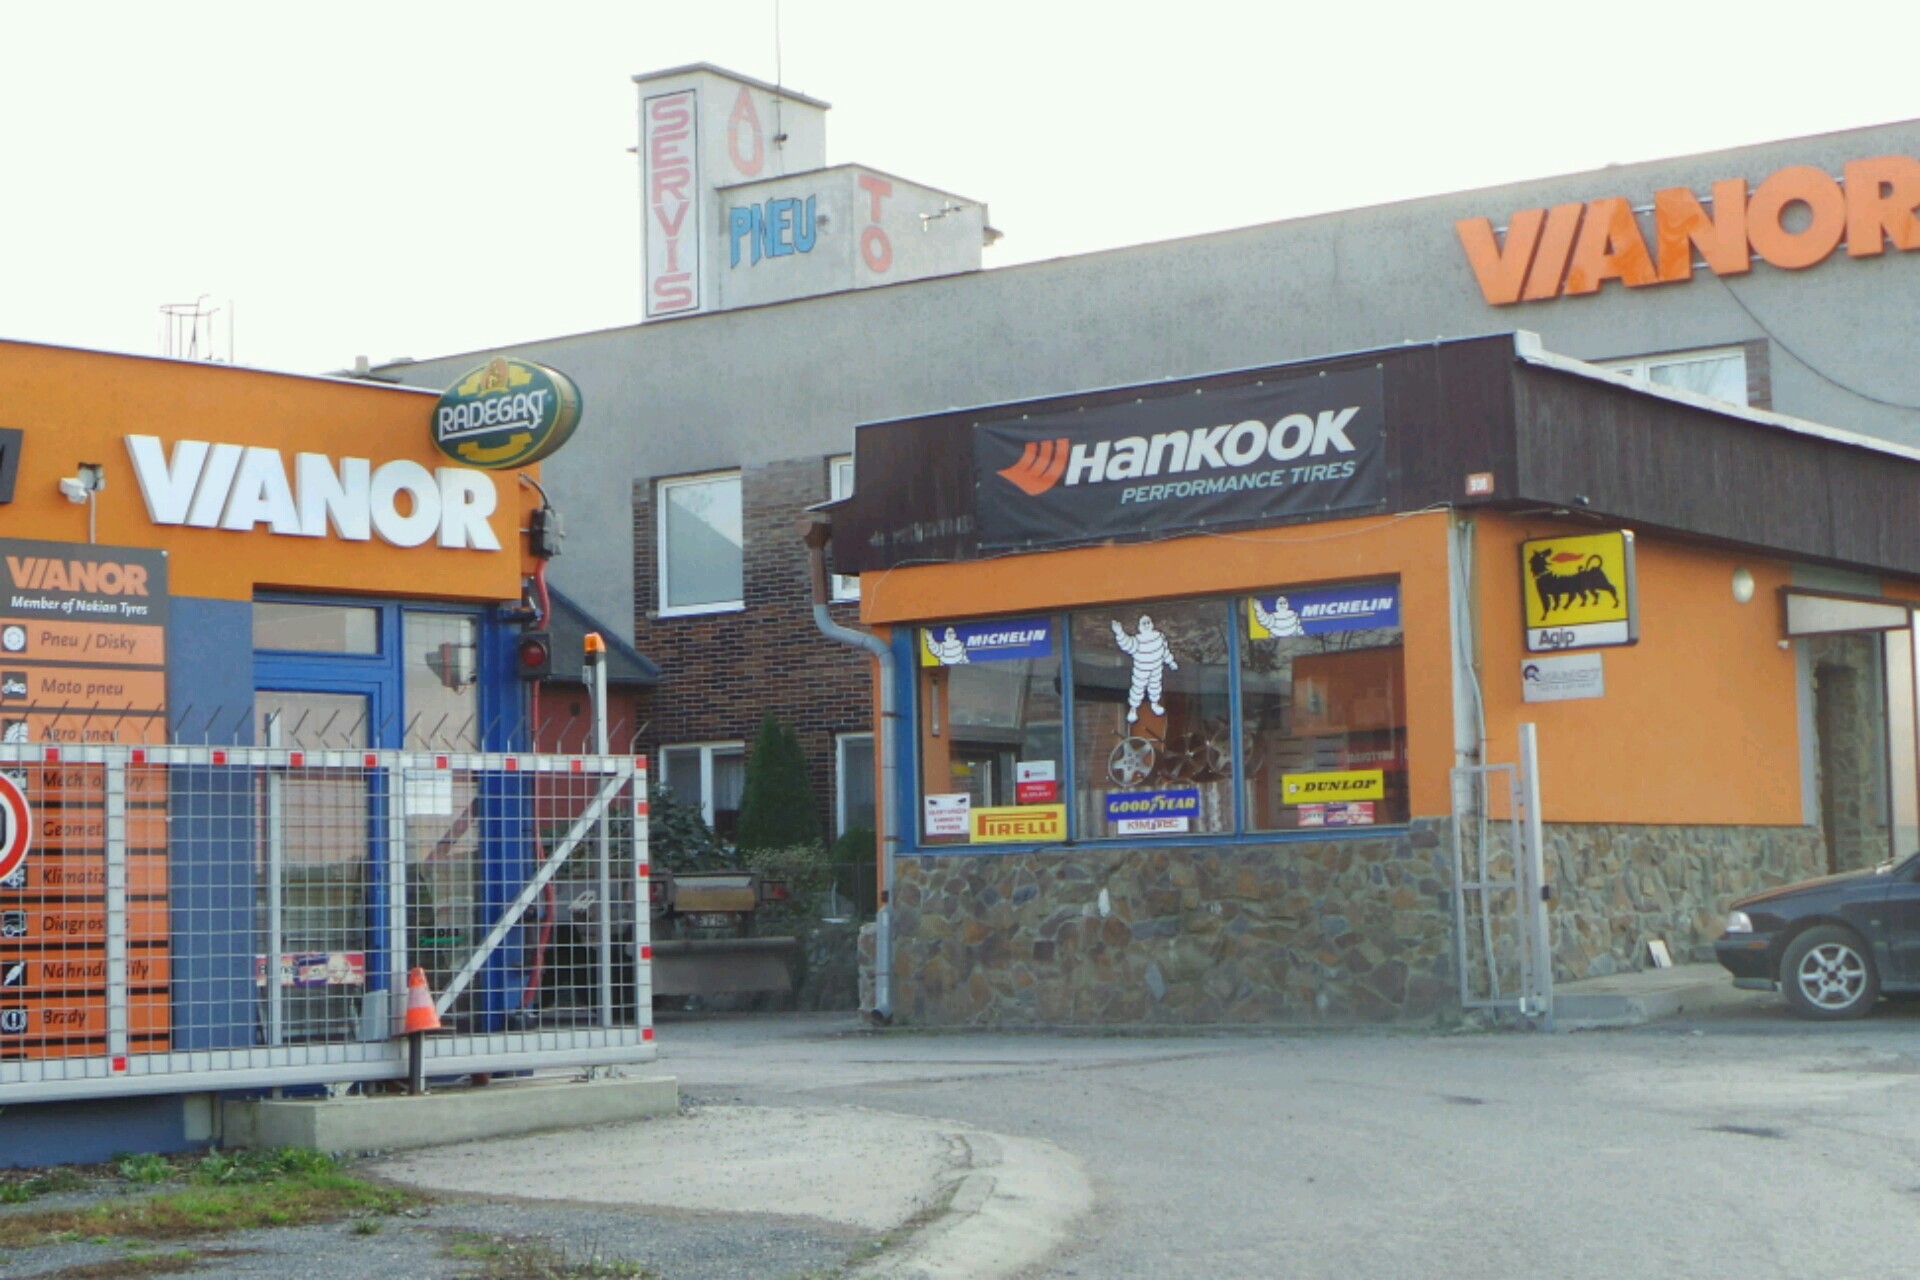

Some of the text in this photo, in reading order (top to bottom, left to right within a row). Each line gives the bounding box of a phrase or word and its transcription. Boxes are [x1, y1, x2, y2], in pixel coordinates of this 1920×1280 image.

[651, 95, 693, 311] SERVIS
[730, 194, 817, 269] PNEU
[1454, 154, 1920, 305] VIANOR
[438, 389, 548, 441] RADEGAST
[124, 434, 502, 550] VIANOR
[1121, 461, 1356, 504] PERFORMANCE TIRES
[5, 556, 149, 596] VIANOR
[11, 596, 149, 617] Member of Nokian Tyres
[1301, 597, 1394, 617] MICHELIN
[41, 631, 79, 647] Pneu
[96, 633, 137, 655] Disky
[966, 629, 1046, 647] MICHELIN
[1538, 628, 1576, 648] Agip
[41, 679, 124, 699] Moto pneu
[1304, 780, 1377, 793] DUNLOP
[1109, 794, 1196, 814] GOODYEAR
[977, 811, 1058, 836] PIRELLI
